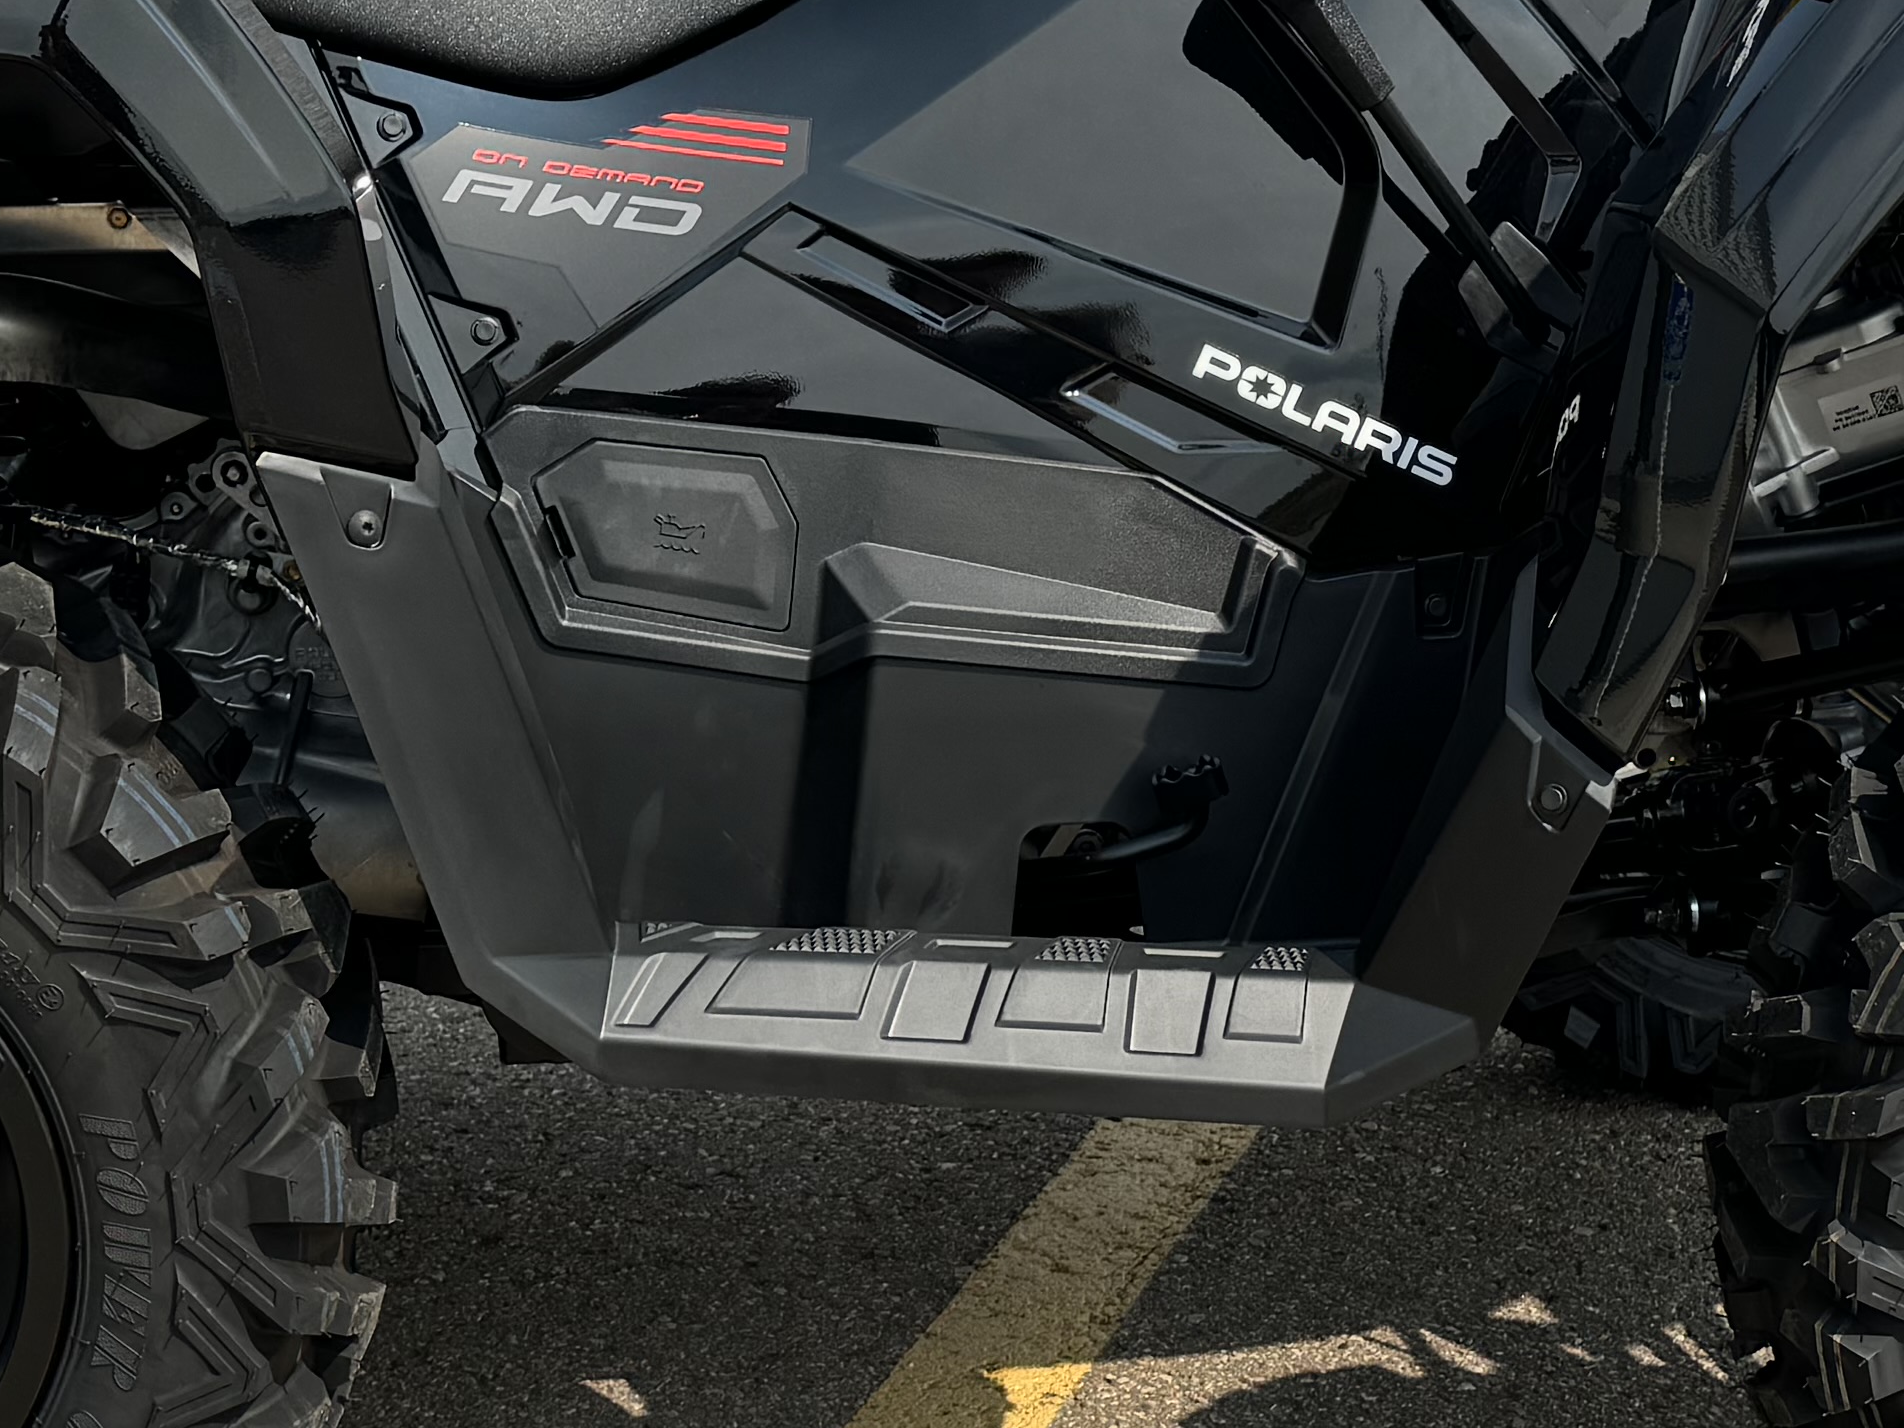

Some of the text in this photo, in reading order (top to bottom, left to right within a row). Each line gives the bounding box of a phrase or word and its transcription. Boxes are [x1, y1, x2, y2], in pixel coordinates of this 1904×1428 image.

[441, 169, 703, 236] AWD
[542, 160, 705, 194] DEMAND
[1192, 343, 1458, 486] POLARIS
[77, 1113, 155, 1392] POWER
